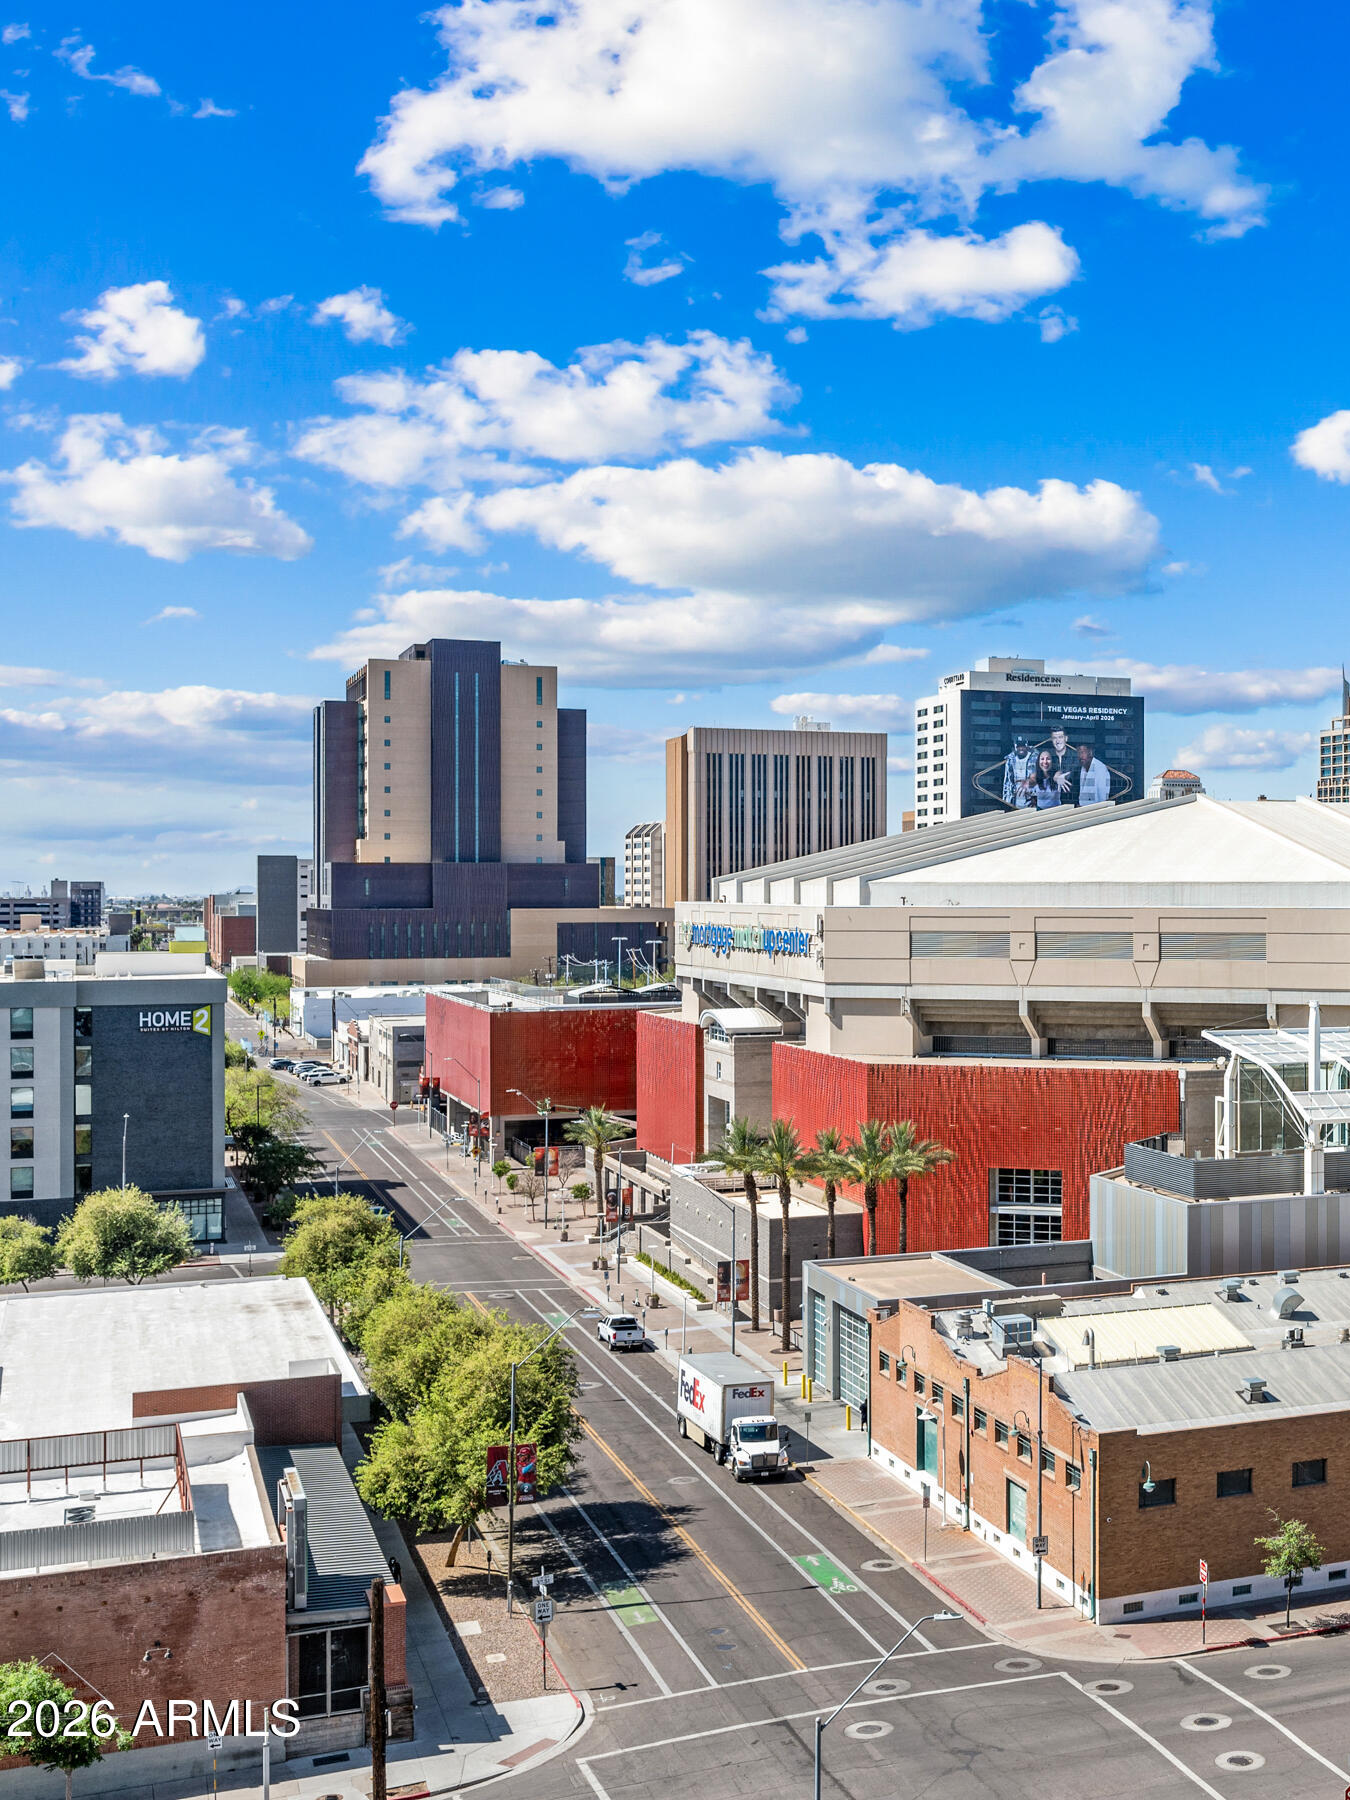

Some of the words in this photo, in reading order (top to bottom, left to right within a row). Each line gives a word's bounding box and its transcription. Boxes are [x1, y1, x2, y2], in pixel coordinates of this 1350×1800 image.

[1006, 673, 1050, 684] Residence
[139, 1011, 192, 1027] HOME
[195, 1009, 209, 1033] 2
[681, 1369, 705, 1413] FedEx
[732, 1387, 765, 1399] FedEx
